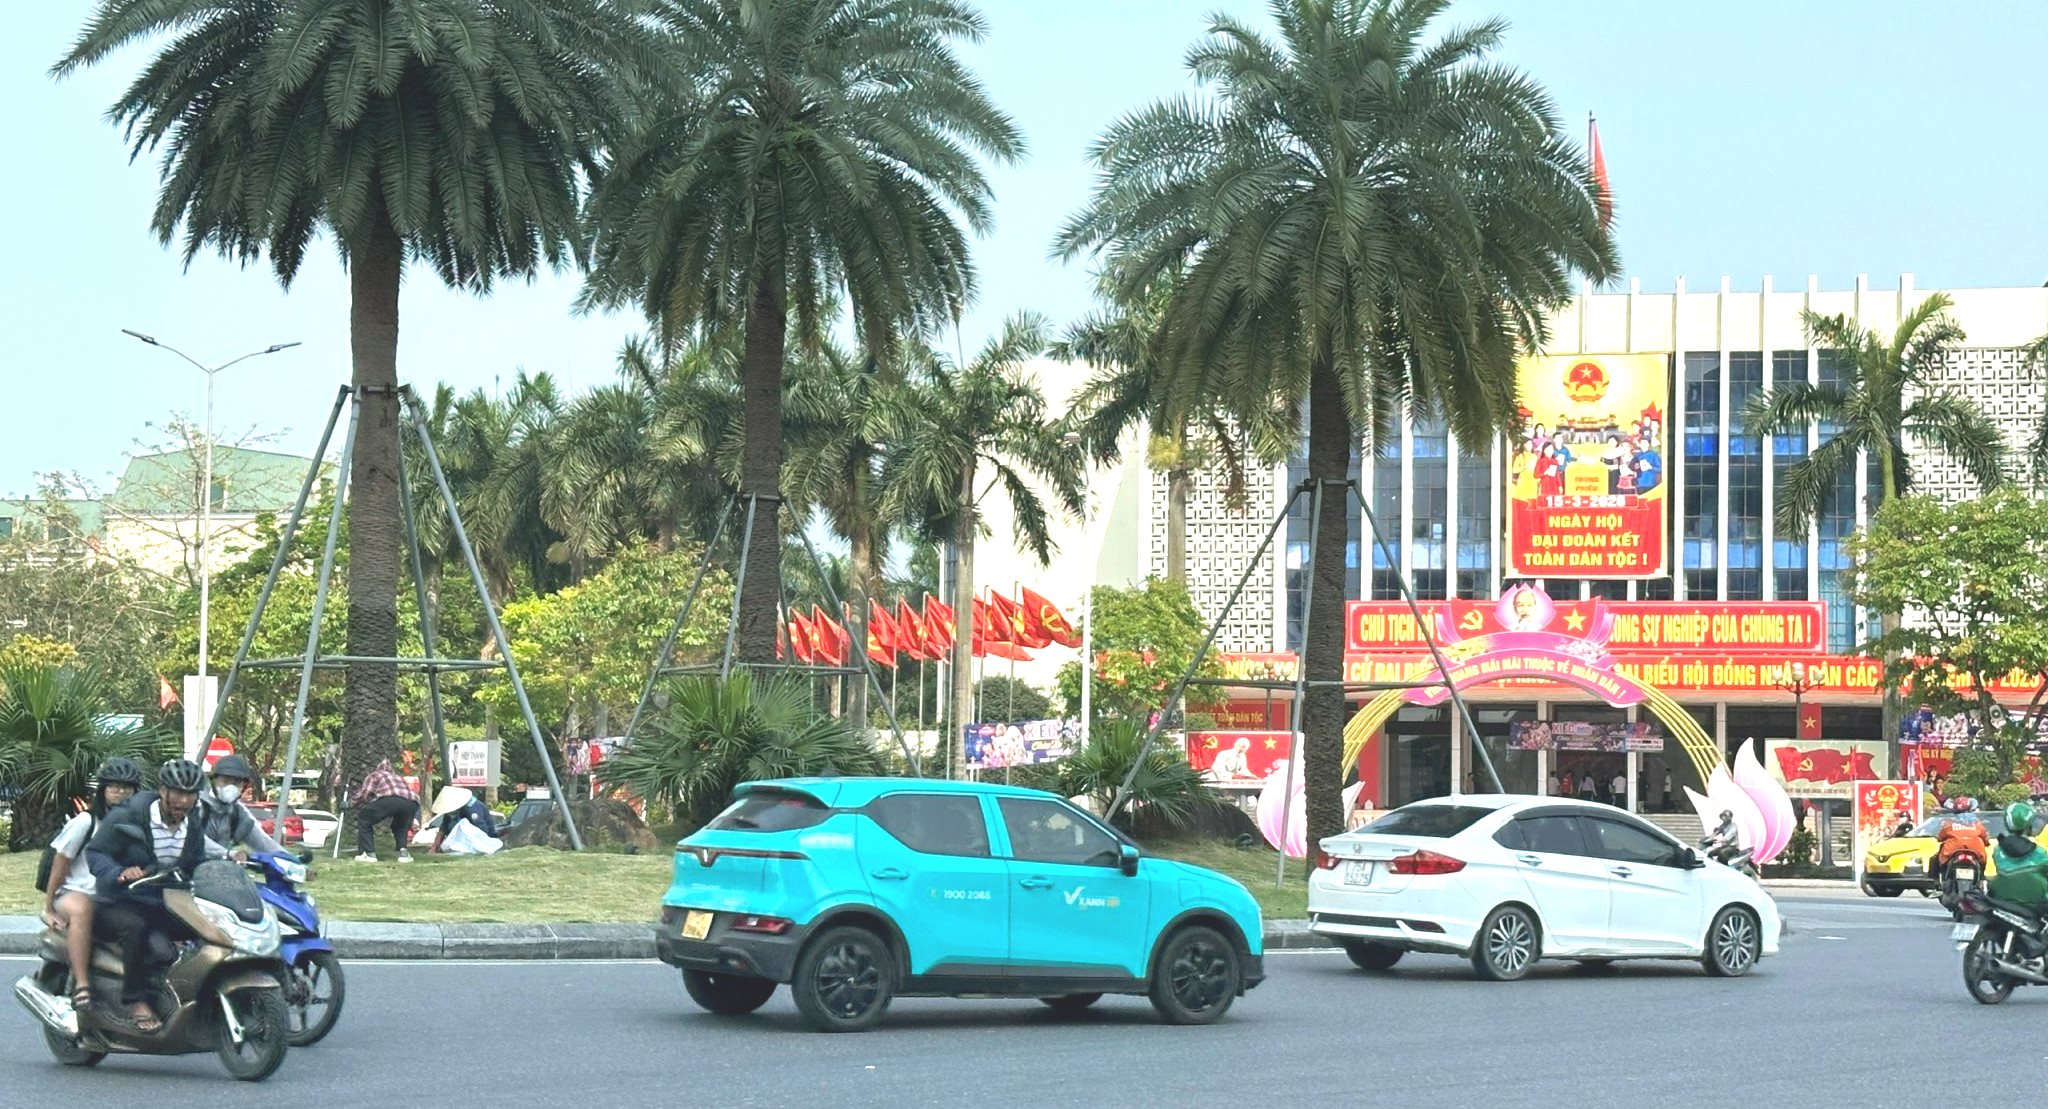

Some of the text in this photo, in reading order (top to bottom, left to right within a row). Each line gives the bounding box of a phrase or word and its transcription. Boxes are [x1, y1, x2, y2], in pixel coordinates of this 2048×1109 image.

[1549, 514, 1623, 530] NGÀY HỘI
[1532, 531, 1640, 549] ĐẠI ĐOÀN KẾT
[1524, 552, 1565, 566] TOÀN
[1569, 552, 1603, 566] DÂN
[1607, 552, 1637, 568] TỘC
[1360, 608, 1385, 642] CHỦ
[1387, 613, 1415, 646] TỊCH
[1642, 613, 1661, 647] SỰ
[1663, 609, 1709, 647] NGHIỆP
[1712, 608, 1738, 643] CỦA
[1741, 609, 1784, 643] CHÚNG
[1787, 614, 1804, 643] TA
[1643, 656, 1679, 686] BIỂU
[1683, 660, 1709, 689] HỘI
[1713, 656, 1756, 686] ĐỒNG
[1846, 661, 1879, 687] CÁC
